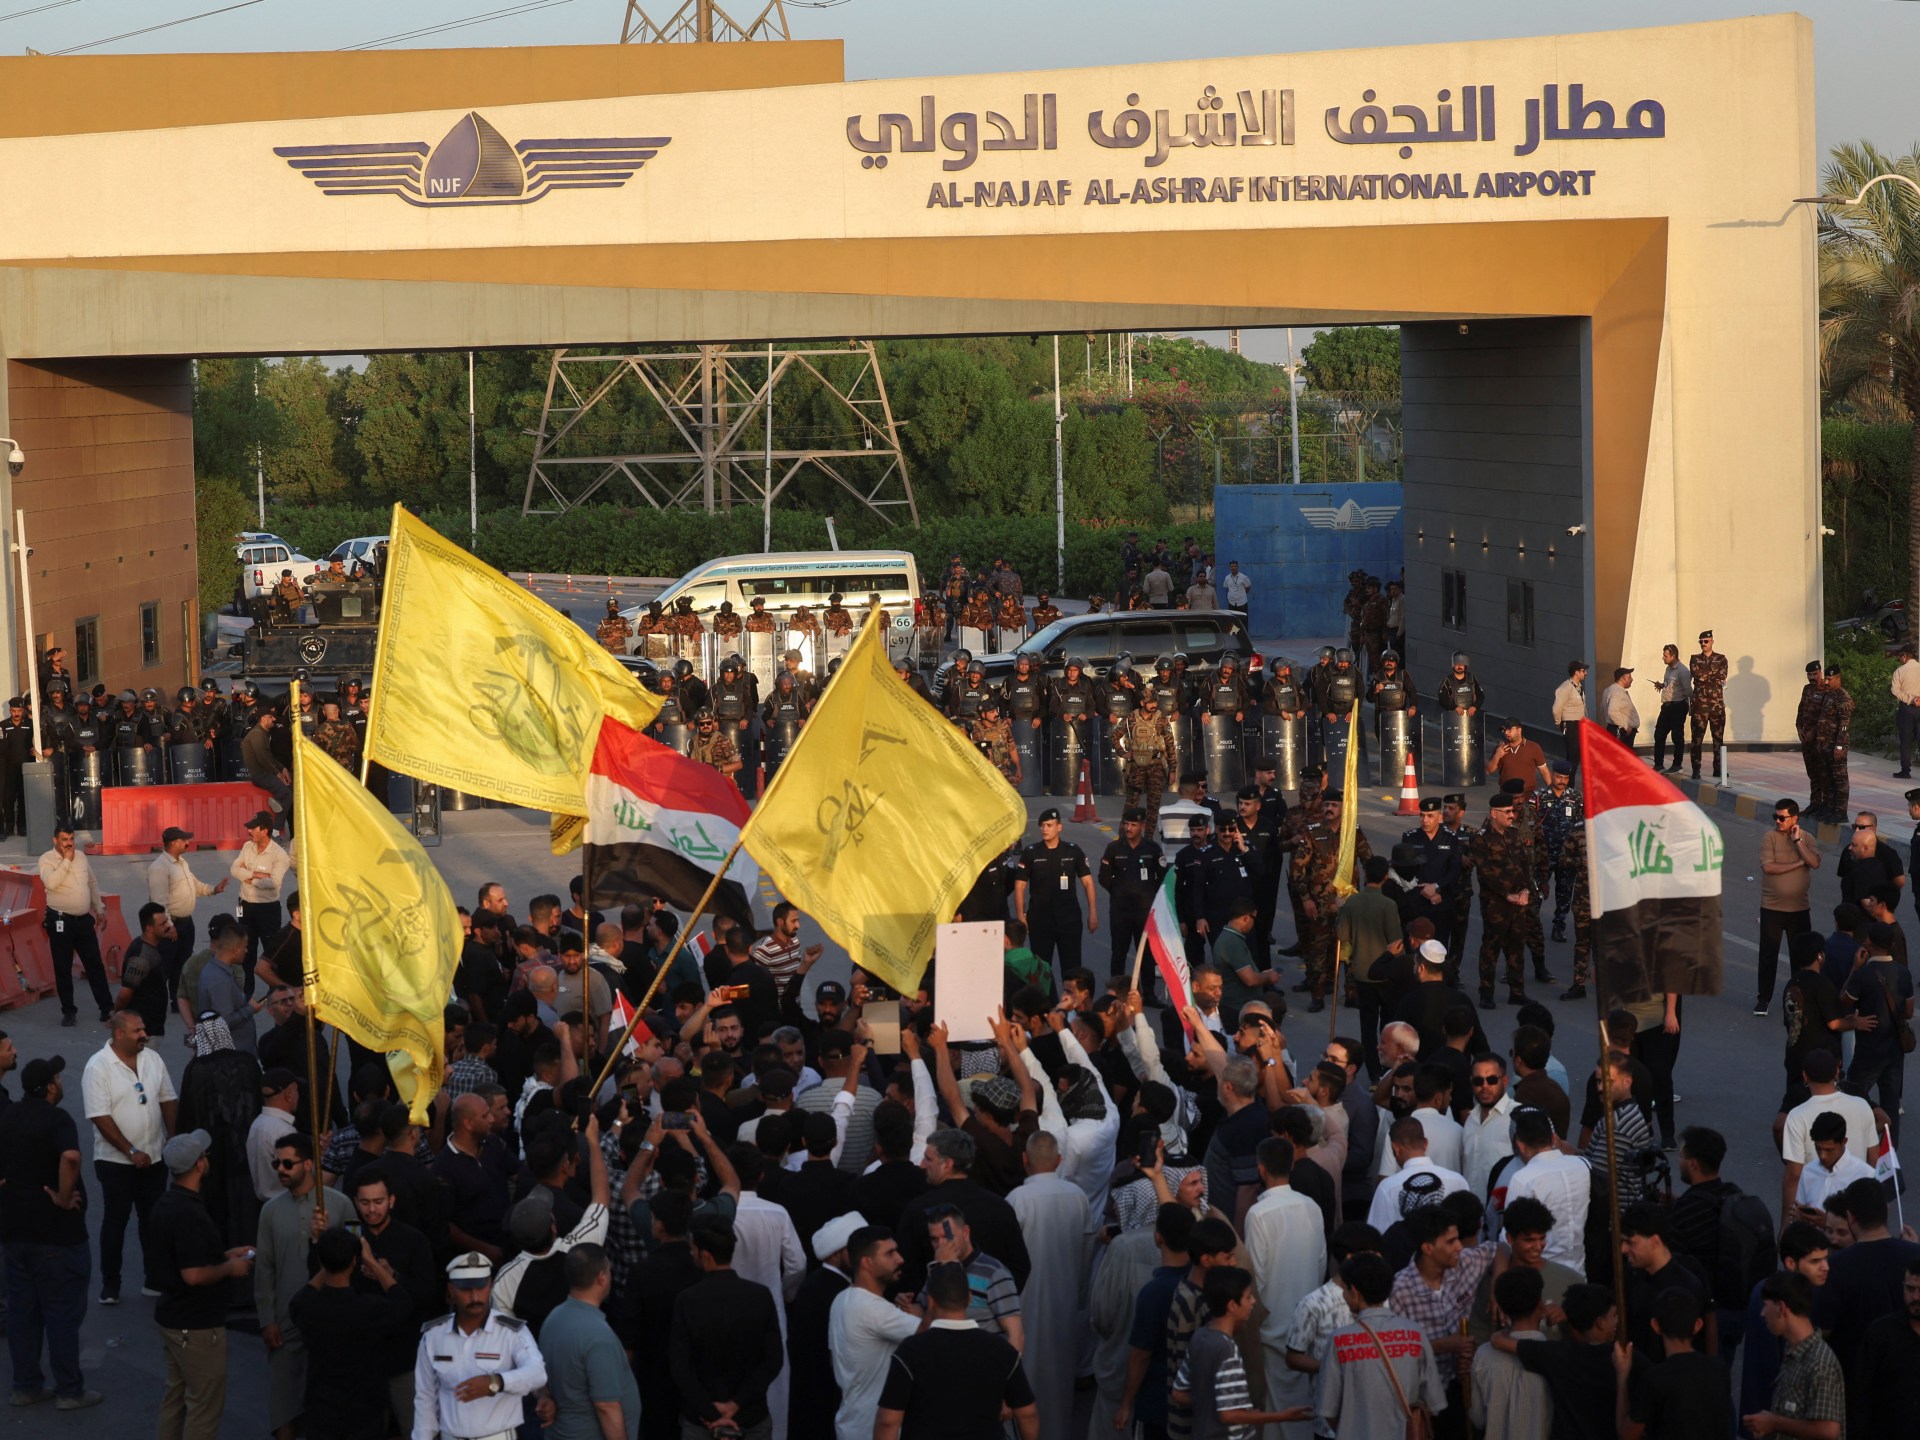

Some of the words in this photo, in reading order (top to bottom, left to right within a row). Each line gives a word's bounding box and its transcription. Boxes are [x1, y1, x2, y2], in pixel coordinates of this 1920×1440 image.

[846, 93, 1057, 171] الدولي
[1088, 85, 1295, 168] الاشرف
[1325, 84, 1496, 160] النجف
[1514, 83, 1666, 156] مطار
[430, 177, 462, 194] NJF
[926, 179, 1072, 209] AL-NAJAF
[1084, 176, 1244, 206] AL-ASHRAF
[1249, 172, 1469, 202] INTERNATIONAL
[1474, 169, 1596, 199] AIRPORT
[896, 618, 910, 627] 66
[919, 656, 938, 664] POLICE
[1333, 1329, 1422, 1349] MEMBRSCLUB
[1337, 1344, 1422, 1365] BOOKEEPER
